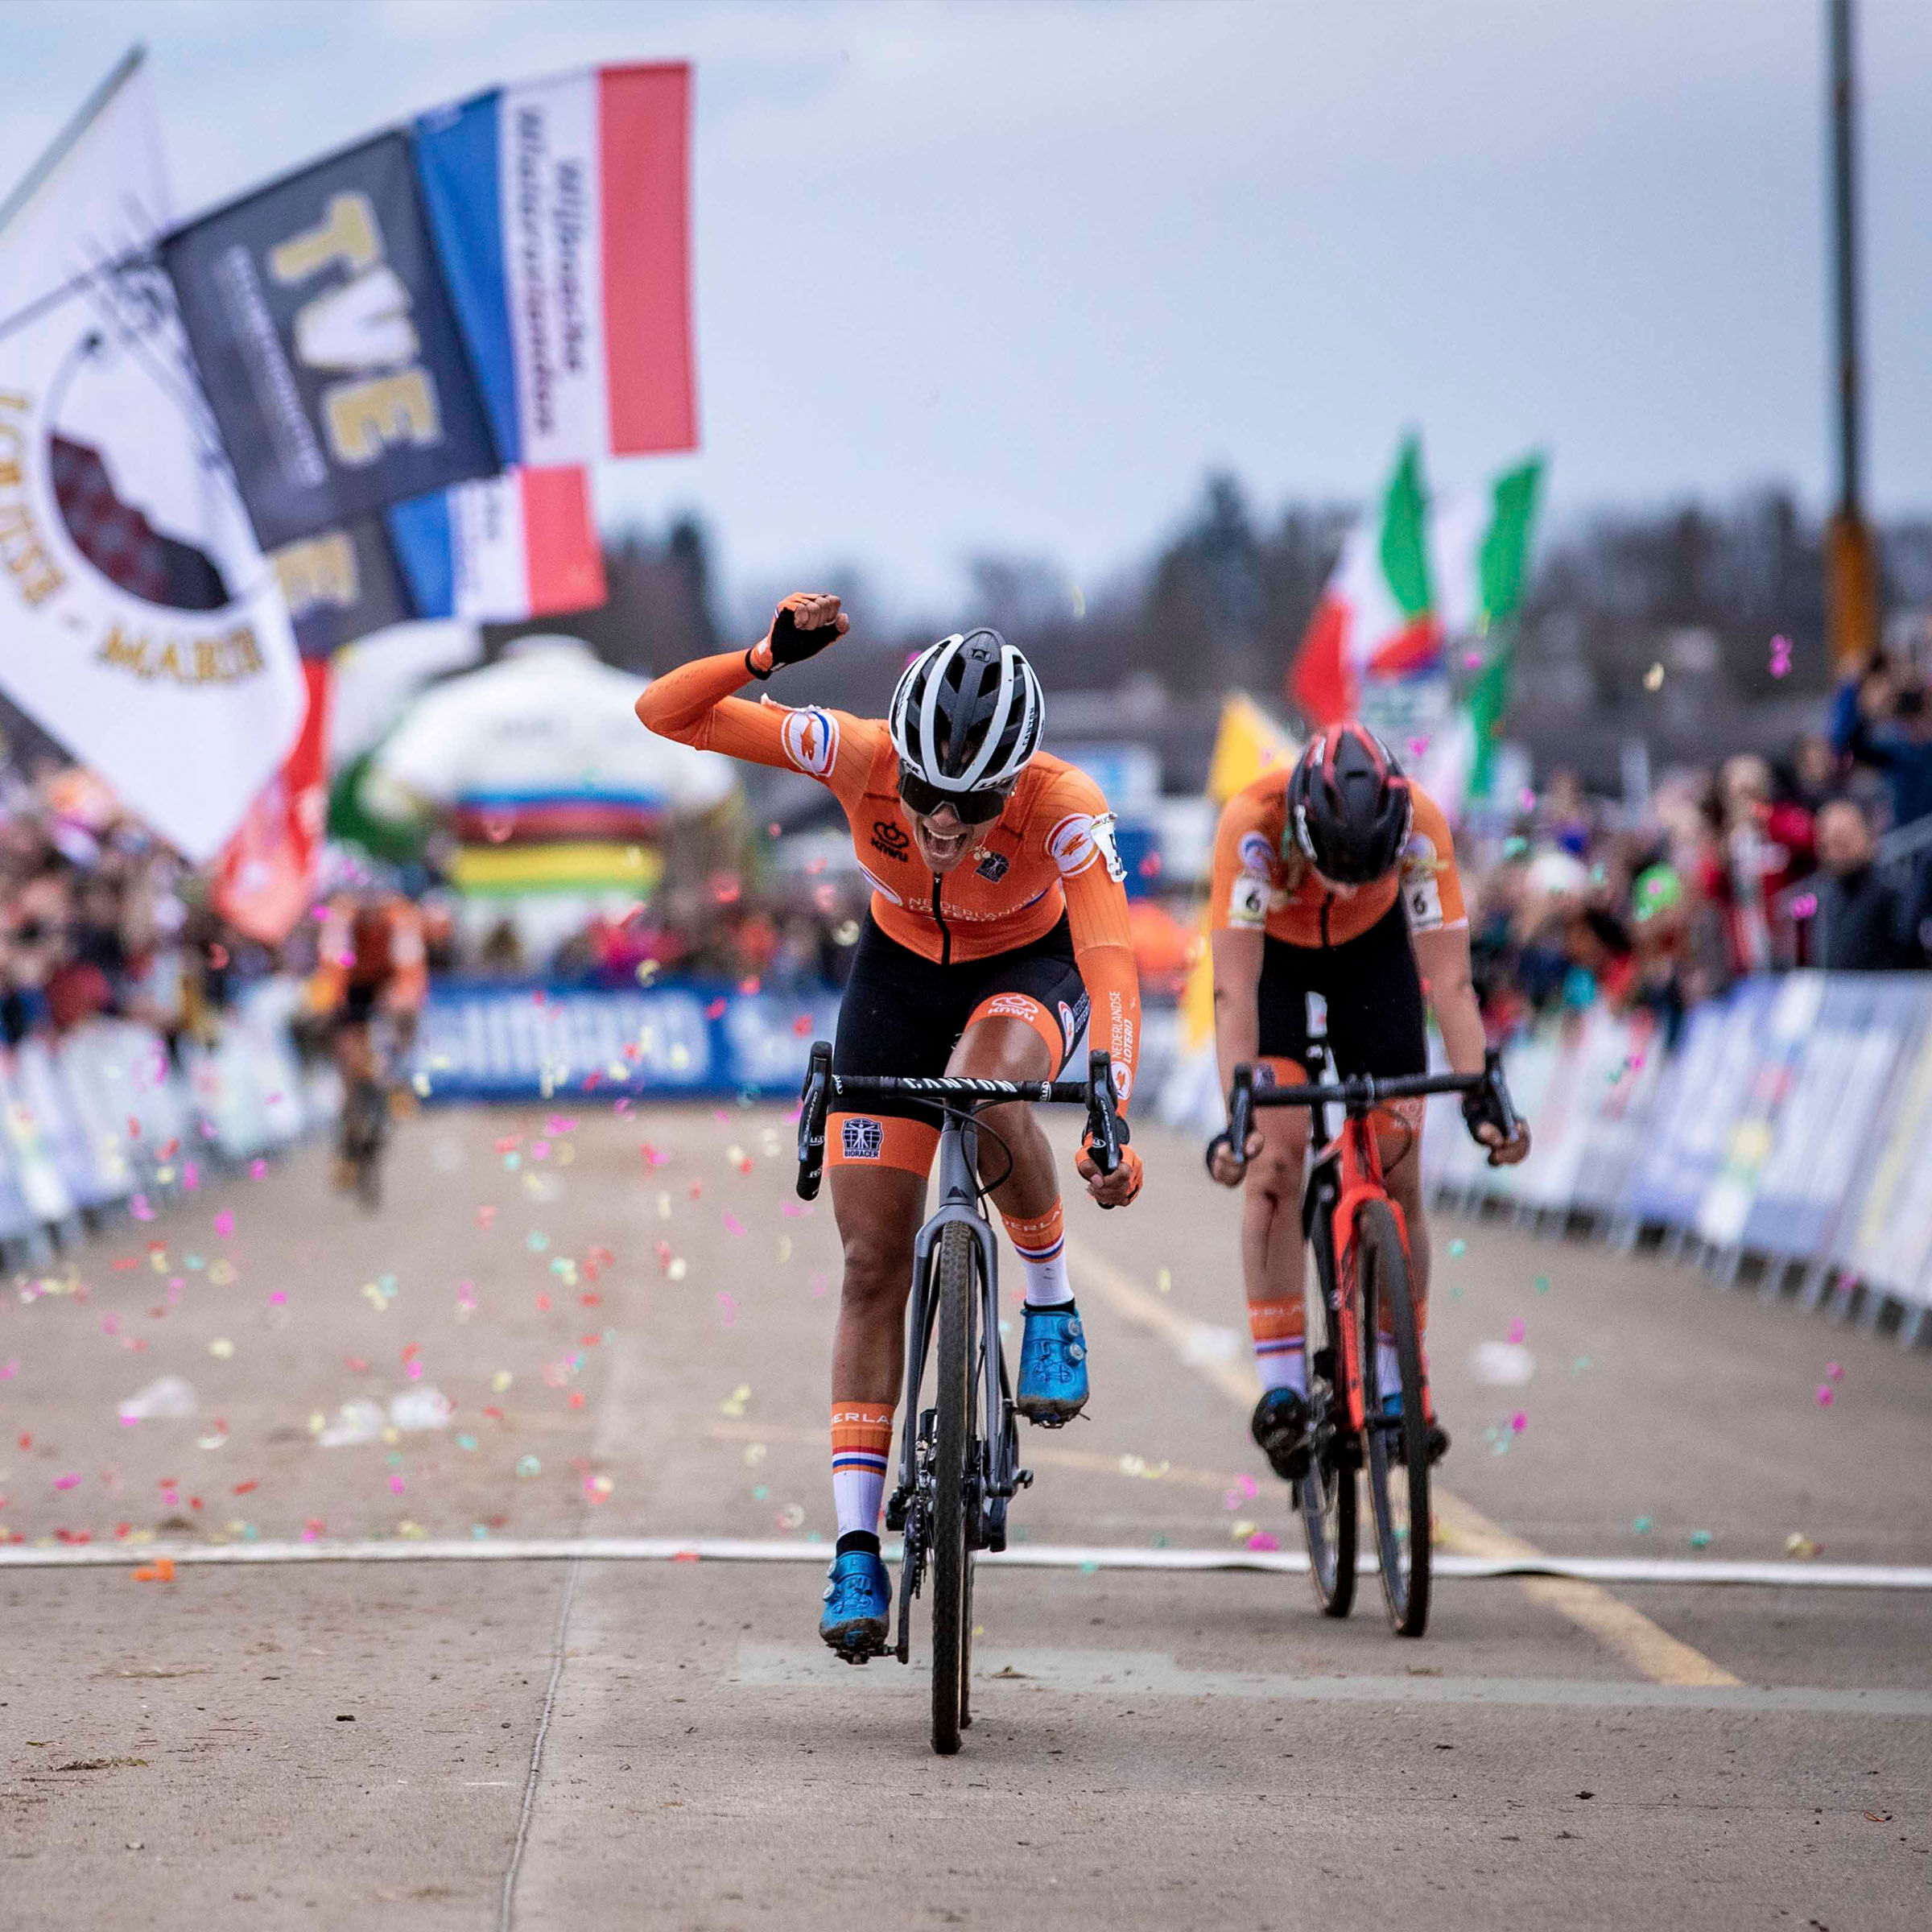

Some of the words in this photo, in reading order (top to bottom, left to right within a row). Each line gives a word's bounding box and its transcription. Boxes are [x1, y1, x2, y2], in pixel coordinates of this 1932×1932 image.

[268, 192, 441, 465] TVE
[1245, 890, 1261, 913] 6
[1413, 890, 1428, 915] 6
[1109, 991, 1124, 1059] NEDERLANDSE
[1122, 1018, 1133, 1064] LOTERIJ
[902, 1077, 1018, 1092] CANYON
[844, 1150, 879, 1158] BIORACER
